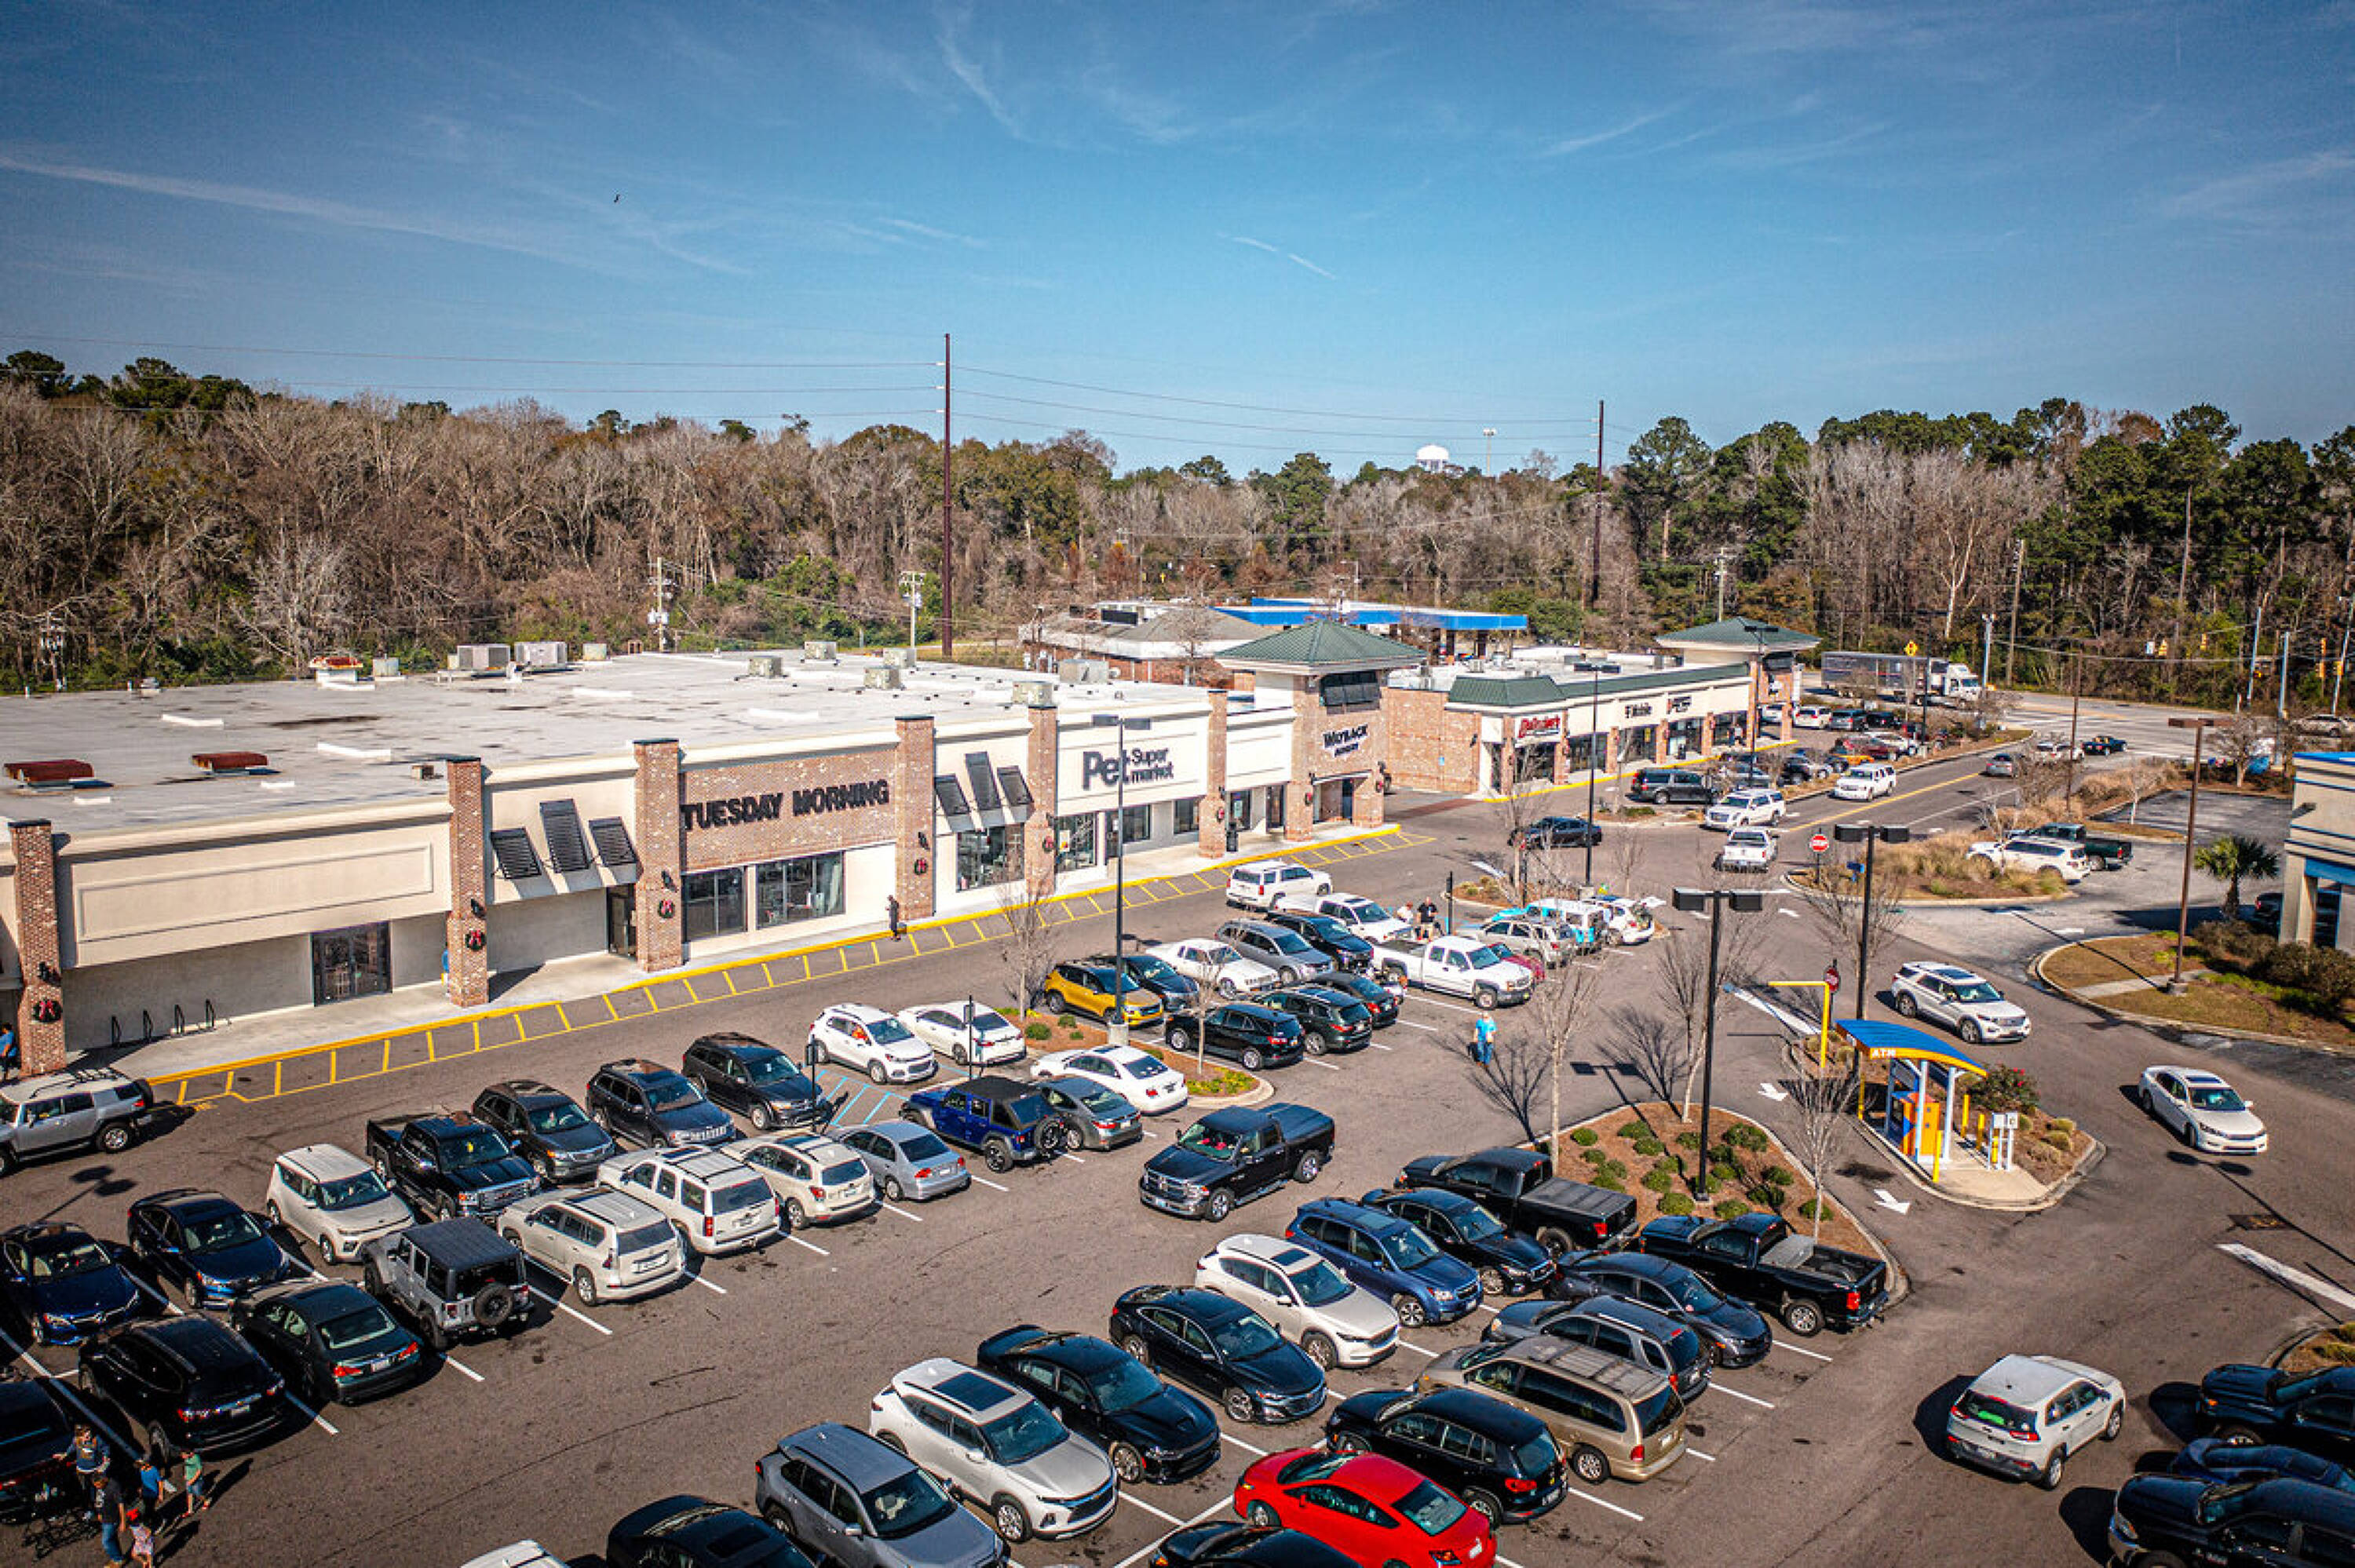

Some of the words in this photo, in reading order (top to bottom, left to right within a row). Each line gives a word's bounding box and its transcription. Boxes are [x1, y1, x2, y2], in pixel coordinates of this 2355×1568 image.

[1083, 749, 1130, 790] Pet
[680, 792, 783, 831] TUESDAY
[793, 779, 890, 816] MORNING
[1871, 1048, 1897, 1058] ATM
